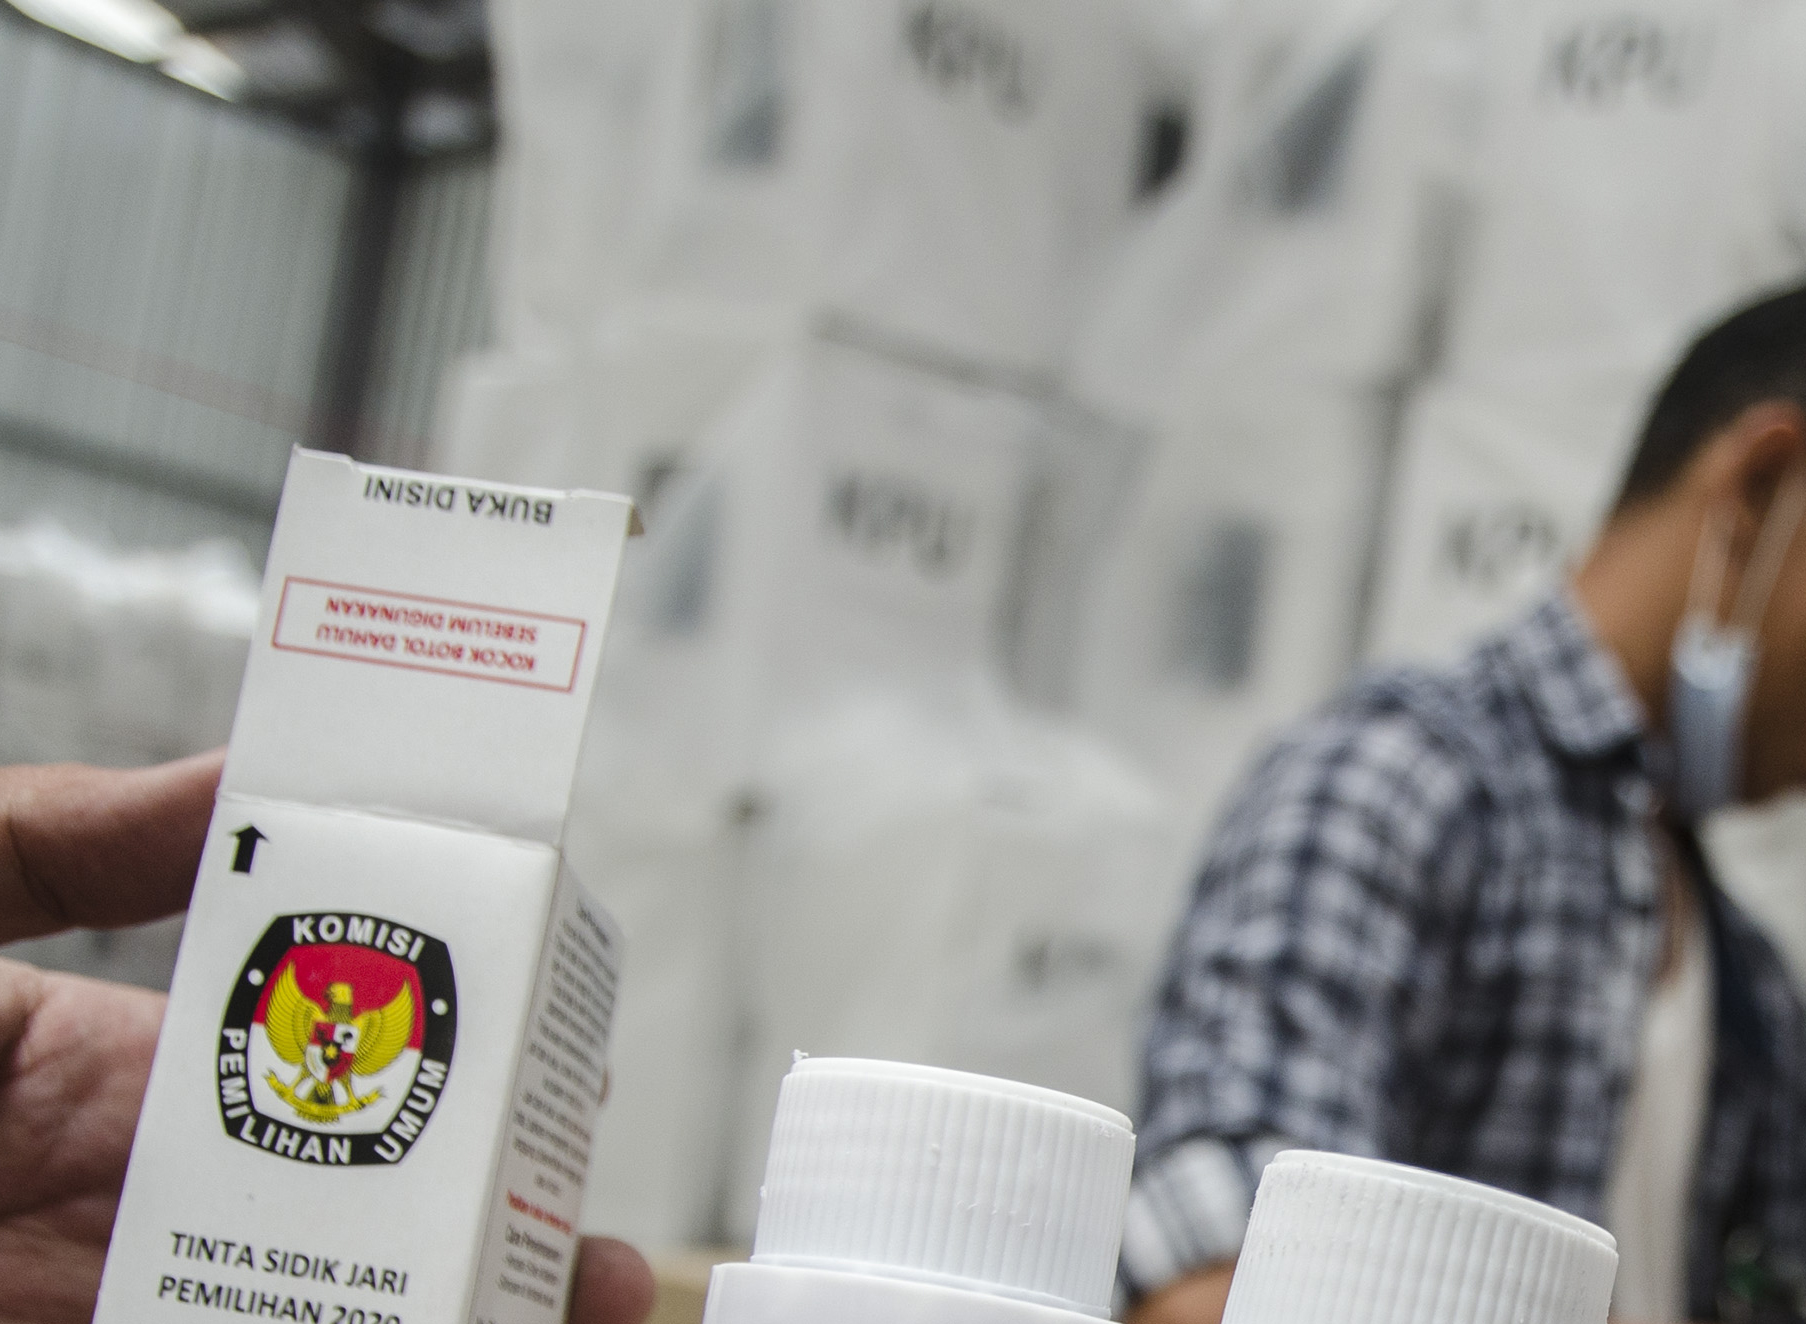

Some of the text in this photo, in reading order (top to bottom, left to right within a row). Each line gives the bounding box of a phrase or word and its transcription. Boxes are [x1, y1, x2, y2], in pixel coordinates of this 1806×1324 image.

[363, 474, 553, 525] BUKA DISINI
[326, 596, 539, 644] SEBELUM DIGUNAKAN
[316, 623, 535, 672] KOCOK BOTOL DAHULU
[293, 915, 425, 963] KOMISI
[219, 1027, 449, 1165] PEMILIHAN UMUM
[170, 1231, 409, 1297] TINTA SIDIK JARI
